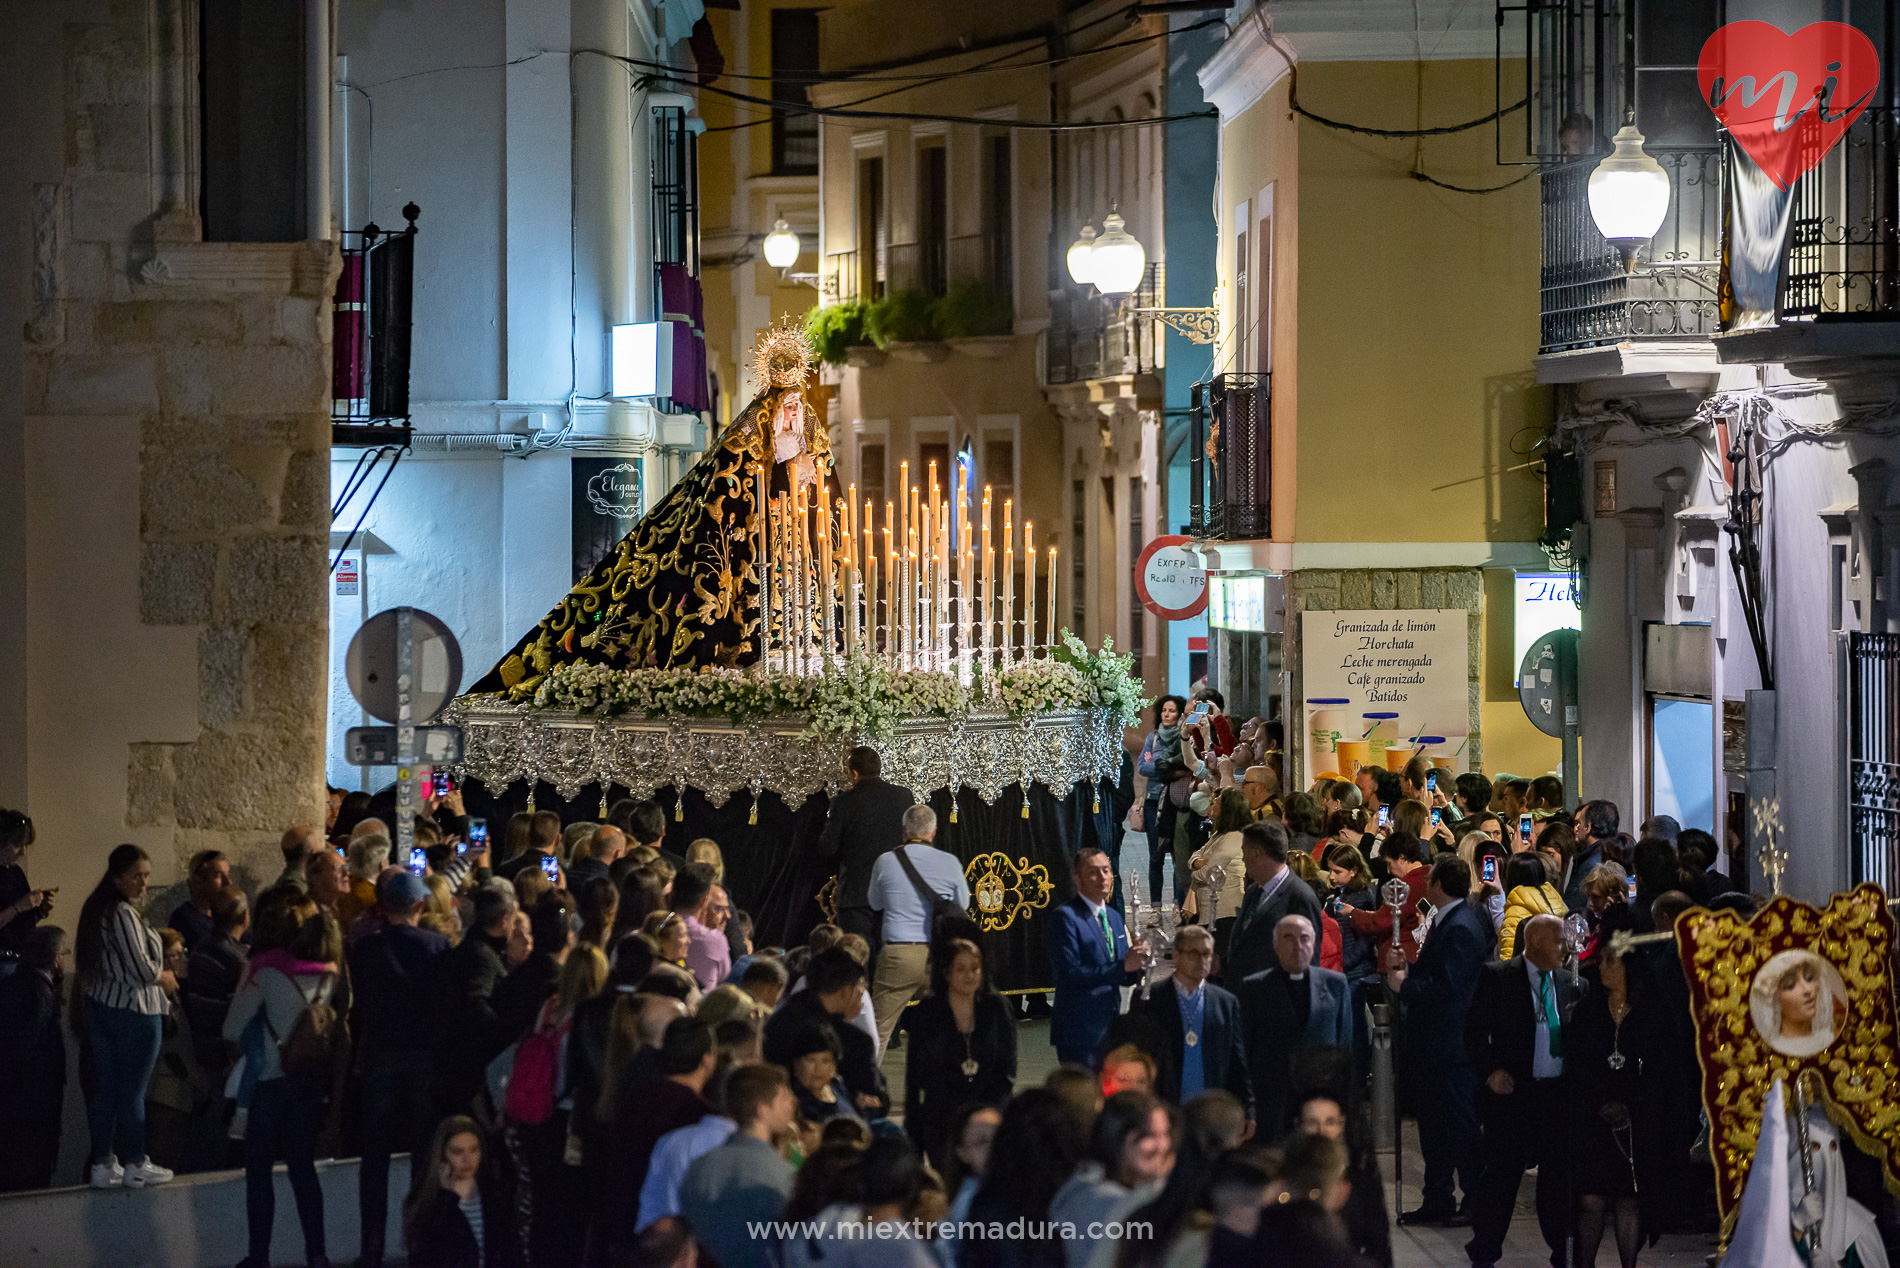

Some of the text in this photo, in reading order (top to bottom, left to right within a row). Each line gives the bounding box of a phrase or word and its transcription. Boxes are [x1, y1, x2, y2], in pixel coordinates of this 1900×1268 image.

[1157, 558, 1186, 568] EXCEP
[1334, 619, 1436, 638] Granizada de limón
[1357, 636, 1414, 650] Horchata
[1340, 654, 1432, 671] Leche merengada
[1347, 672, 1426, 689] Café granizado
[1365, 689, 1408, 702] Batidos
